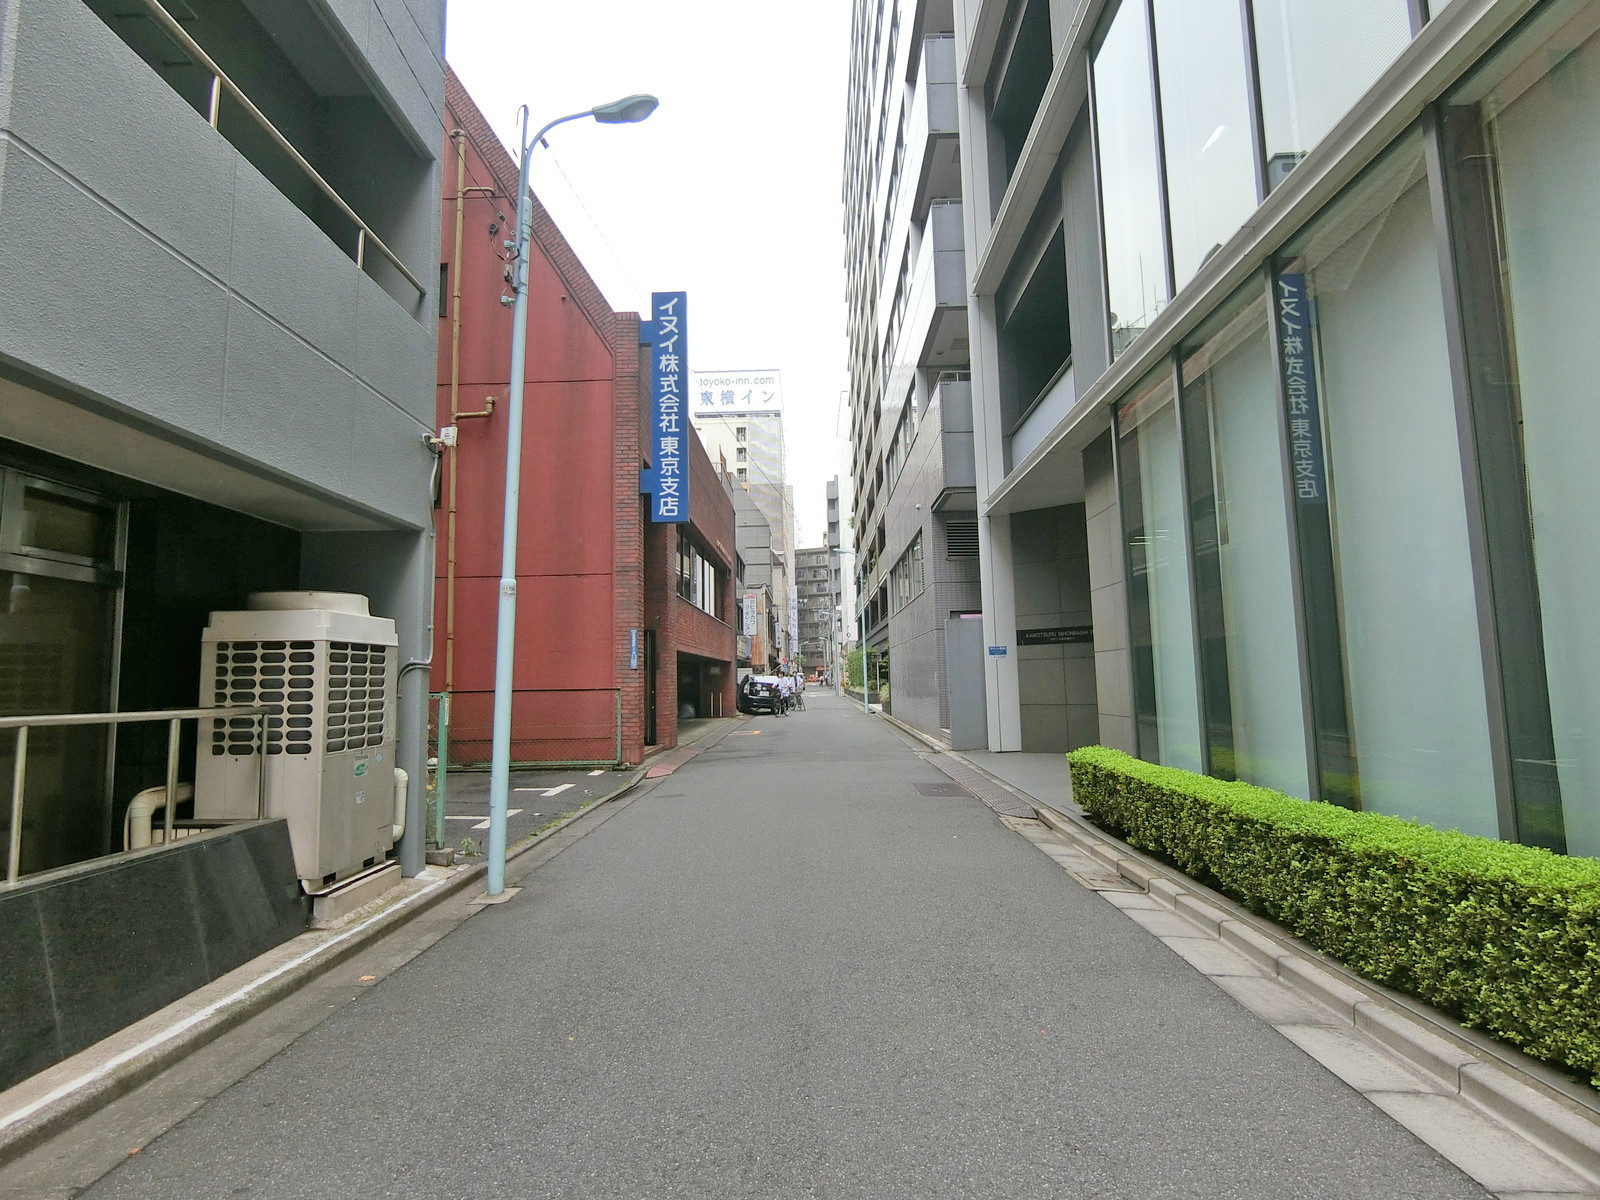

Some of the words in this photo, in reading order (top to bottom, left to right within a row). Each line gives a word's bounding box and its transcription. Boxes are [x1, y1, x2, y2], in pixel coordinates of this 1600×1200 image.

[699, 376, 775, 388] toyoko-inn.com
[699, 389, 775, 406] 東横イン
